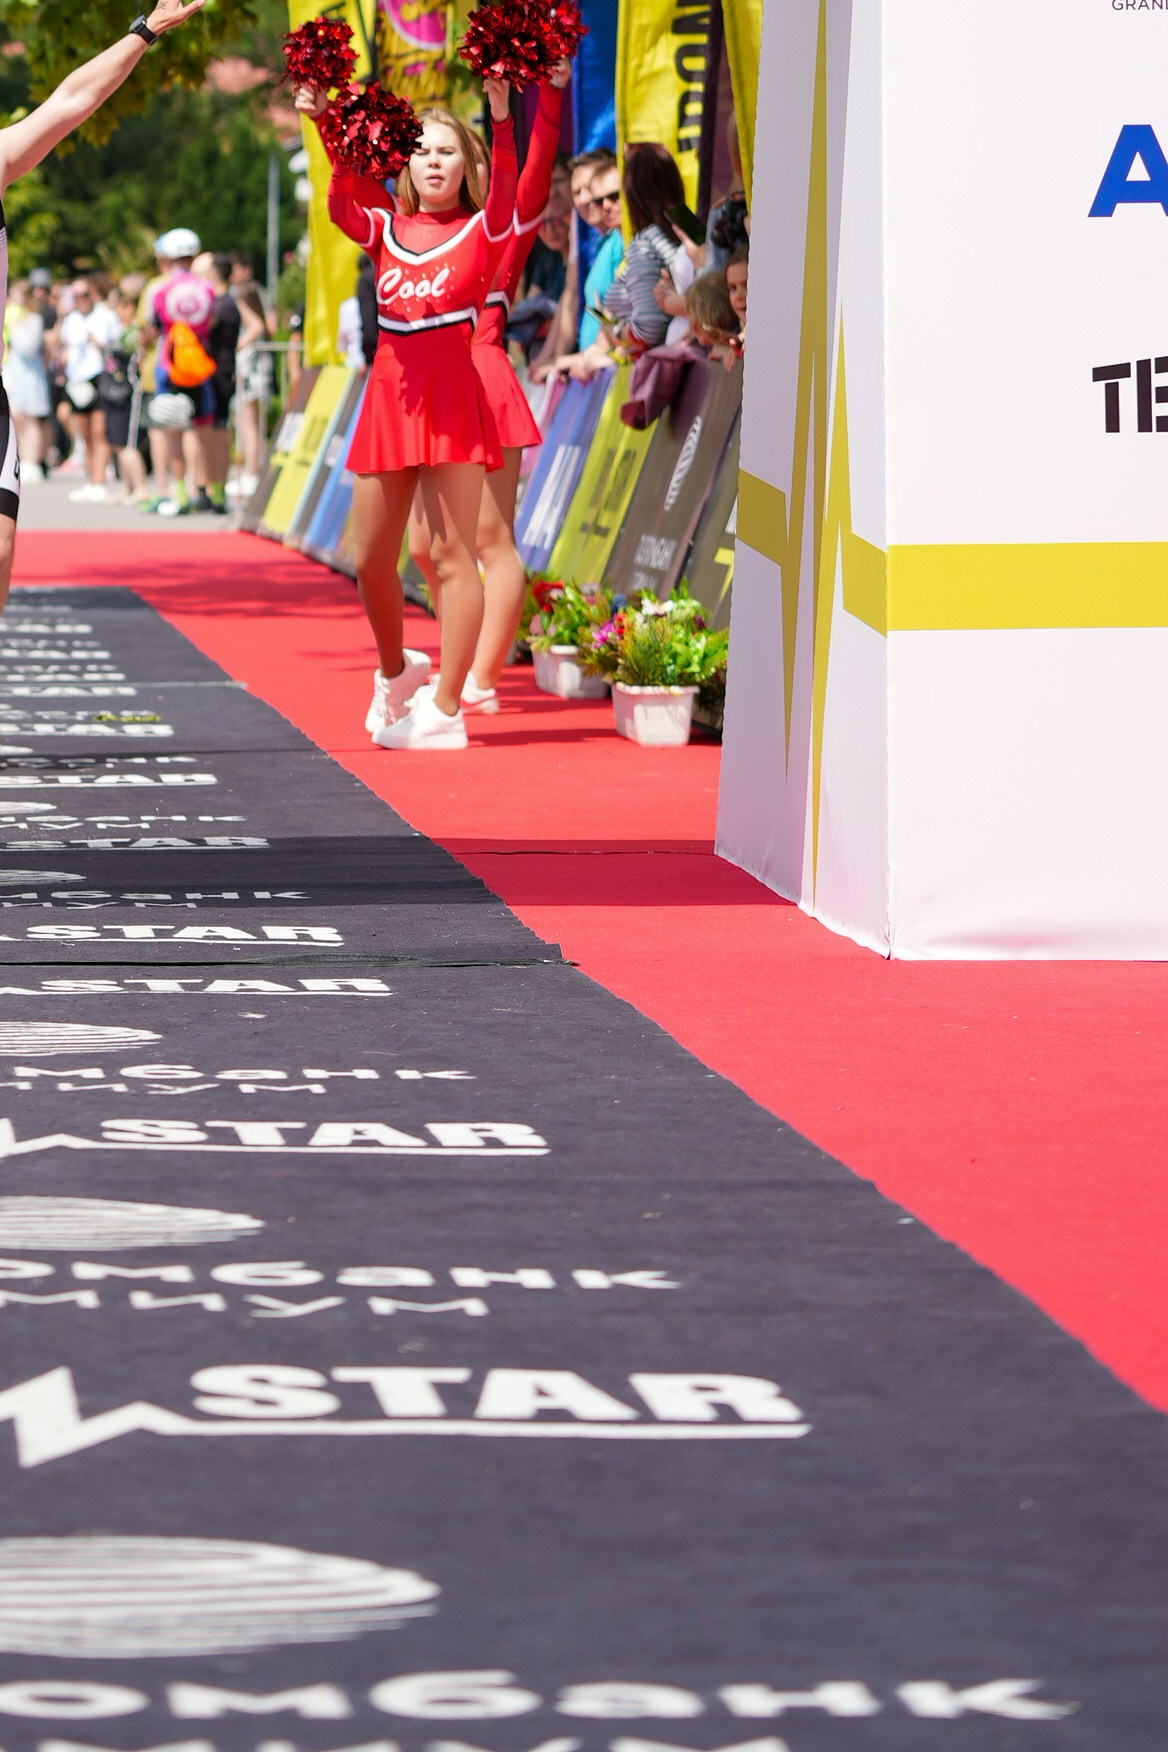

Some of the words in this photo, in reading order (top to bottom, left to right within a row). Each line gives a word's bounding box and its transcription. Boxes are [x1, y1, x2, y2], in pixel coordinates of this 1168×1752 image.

[376, 267, 450, 306] Cool
[6, 837, 270, 849] STAR
[27, 924, 345, 941] STAR
[42, 978, 392, 993] STAR
[100, 1118, 549, 1148] STAR
[189, 1363, 803, 1423] STAR
